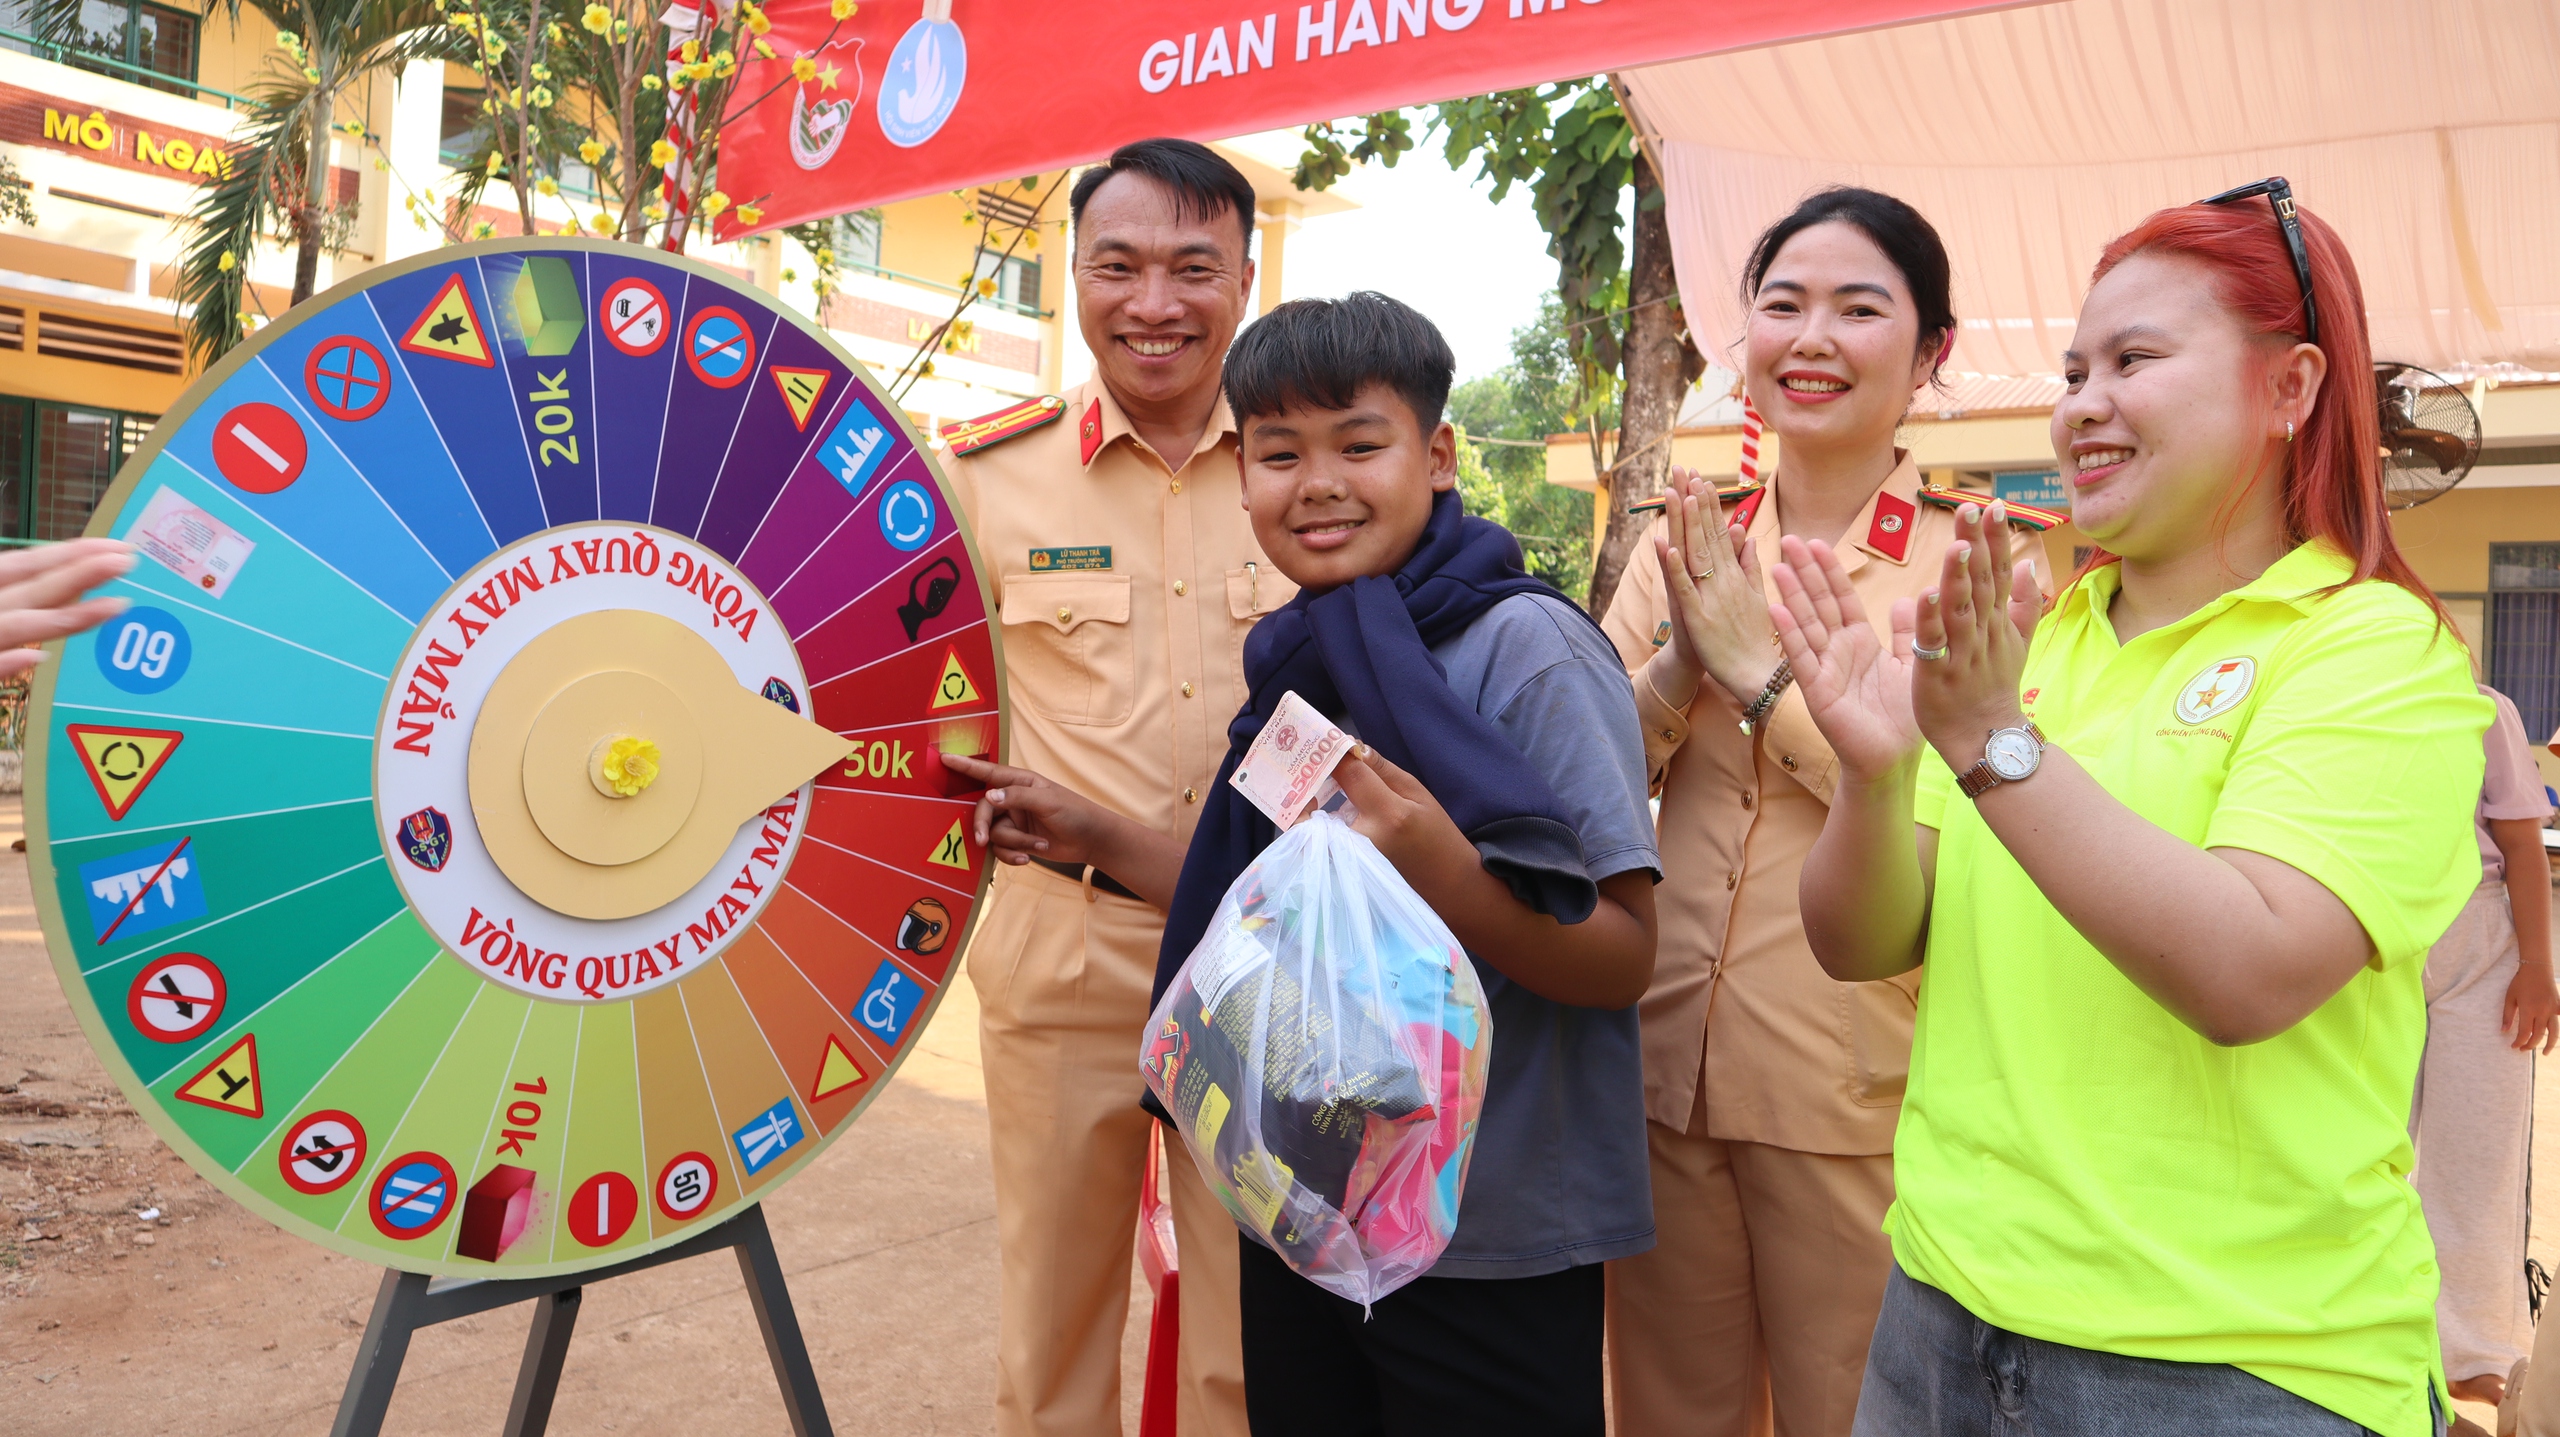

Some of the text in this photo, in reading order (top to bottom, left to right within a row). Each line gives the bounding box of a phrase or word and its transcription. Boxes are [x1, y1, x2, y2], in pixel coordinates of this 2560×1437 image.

[1139, 14, 1276, 93] GIAN
[529, 368, 579, 467] 20k
[548, 532, 660, 585] QUAY
[448, 556, 545, 649] MAY
[668, 551, 759, 642] VÒNG
[1274, 710, 1287, 728] NAM
[2210, 728, 2233, 743] ĐỒNG
[844, 740, 914, 778] 50k
[410, 832, 446, 856] CSGT
[458, 907, 568, 989] VÒNG
[575, 933, 684, 999] QUAY
[686, 864, 764, 954] MAY
[1360, 1074, 1379, 1090] NAM
[496, 1076, 548, 1158] 10k
[1312, 1104, 1328, 1126] CÔNG
[673, 1169, 702, 1202] 50
